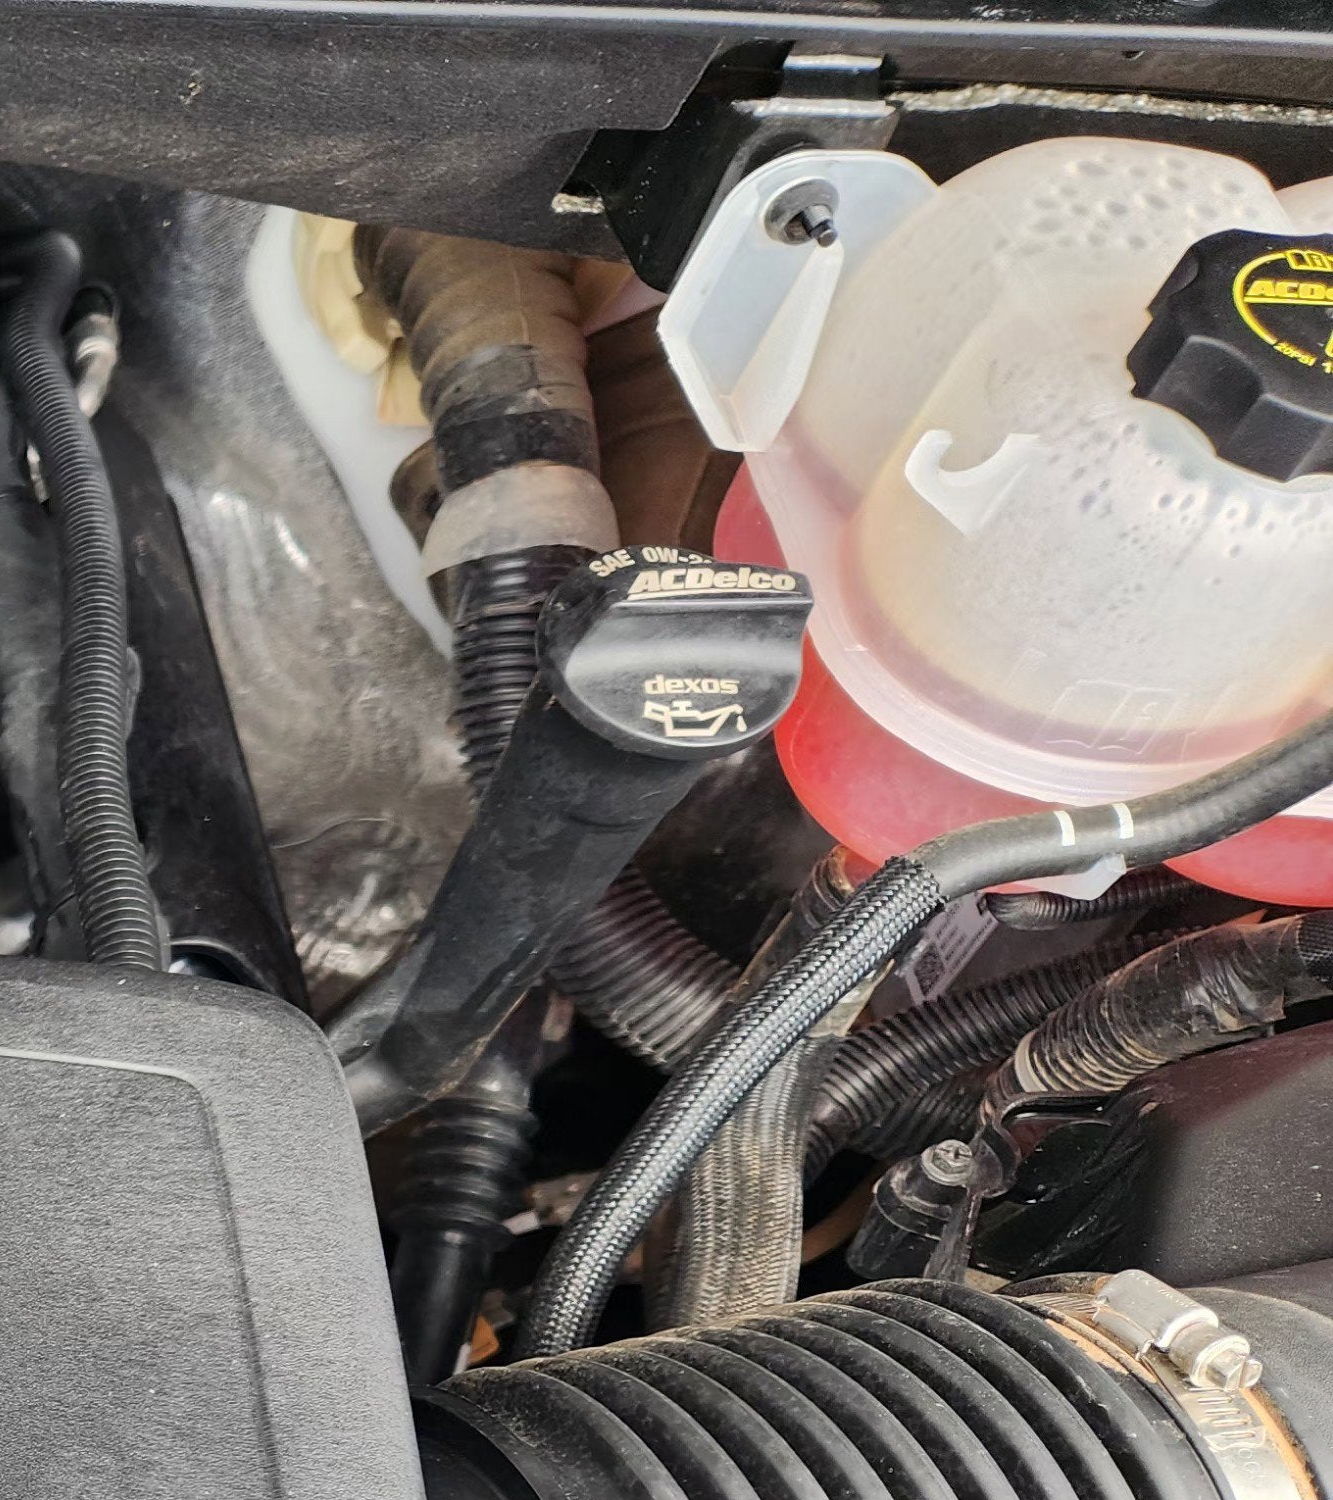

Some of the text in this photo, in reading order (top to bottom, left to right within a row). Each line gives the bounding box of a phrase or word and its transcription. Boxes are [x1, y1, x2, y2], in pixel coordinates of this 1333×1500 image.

[1245, 279, 1333, 300] ACD
[589, 546, 713, 578] SAE 0W-2
[627, 567, 797, 594] ACDelco
[644, 674, 740, 695] dexos
